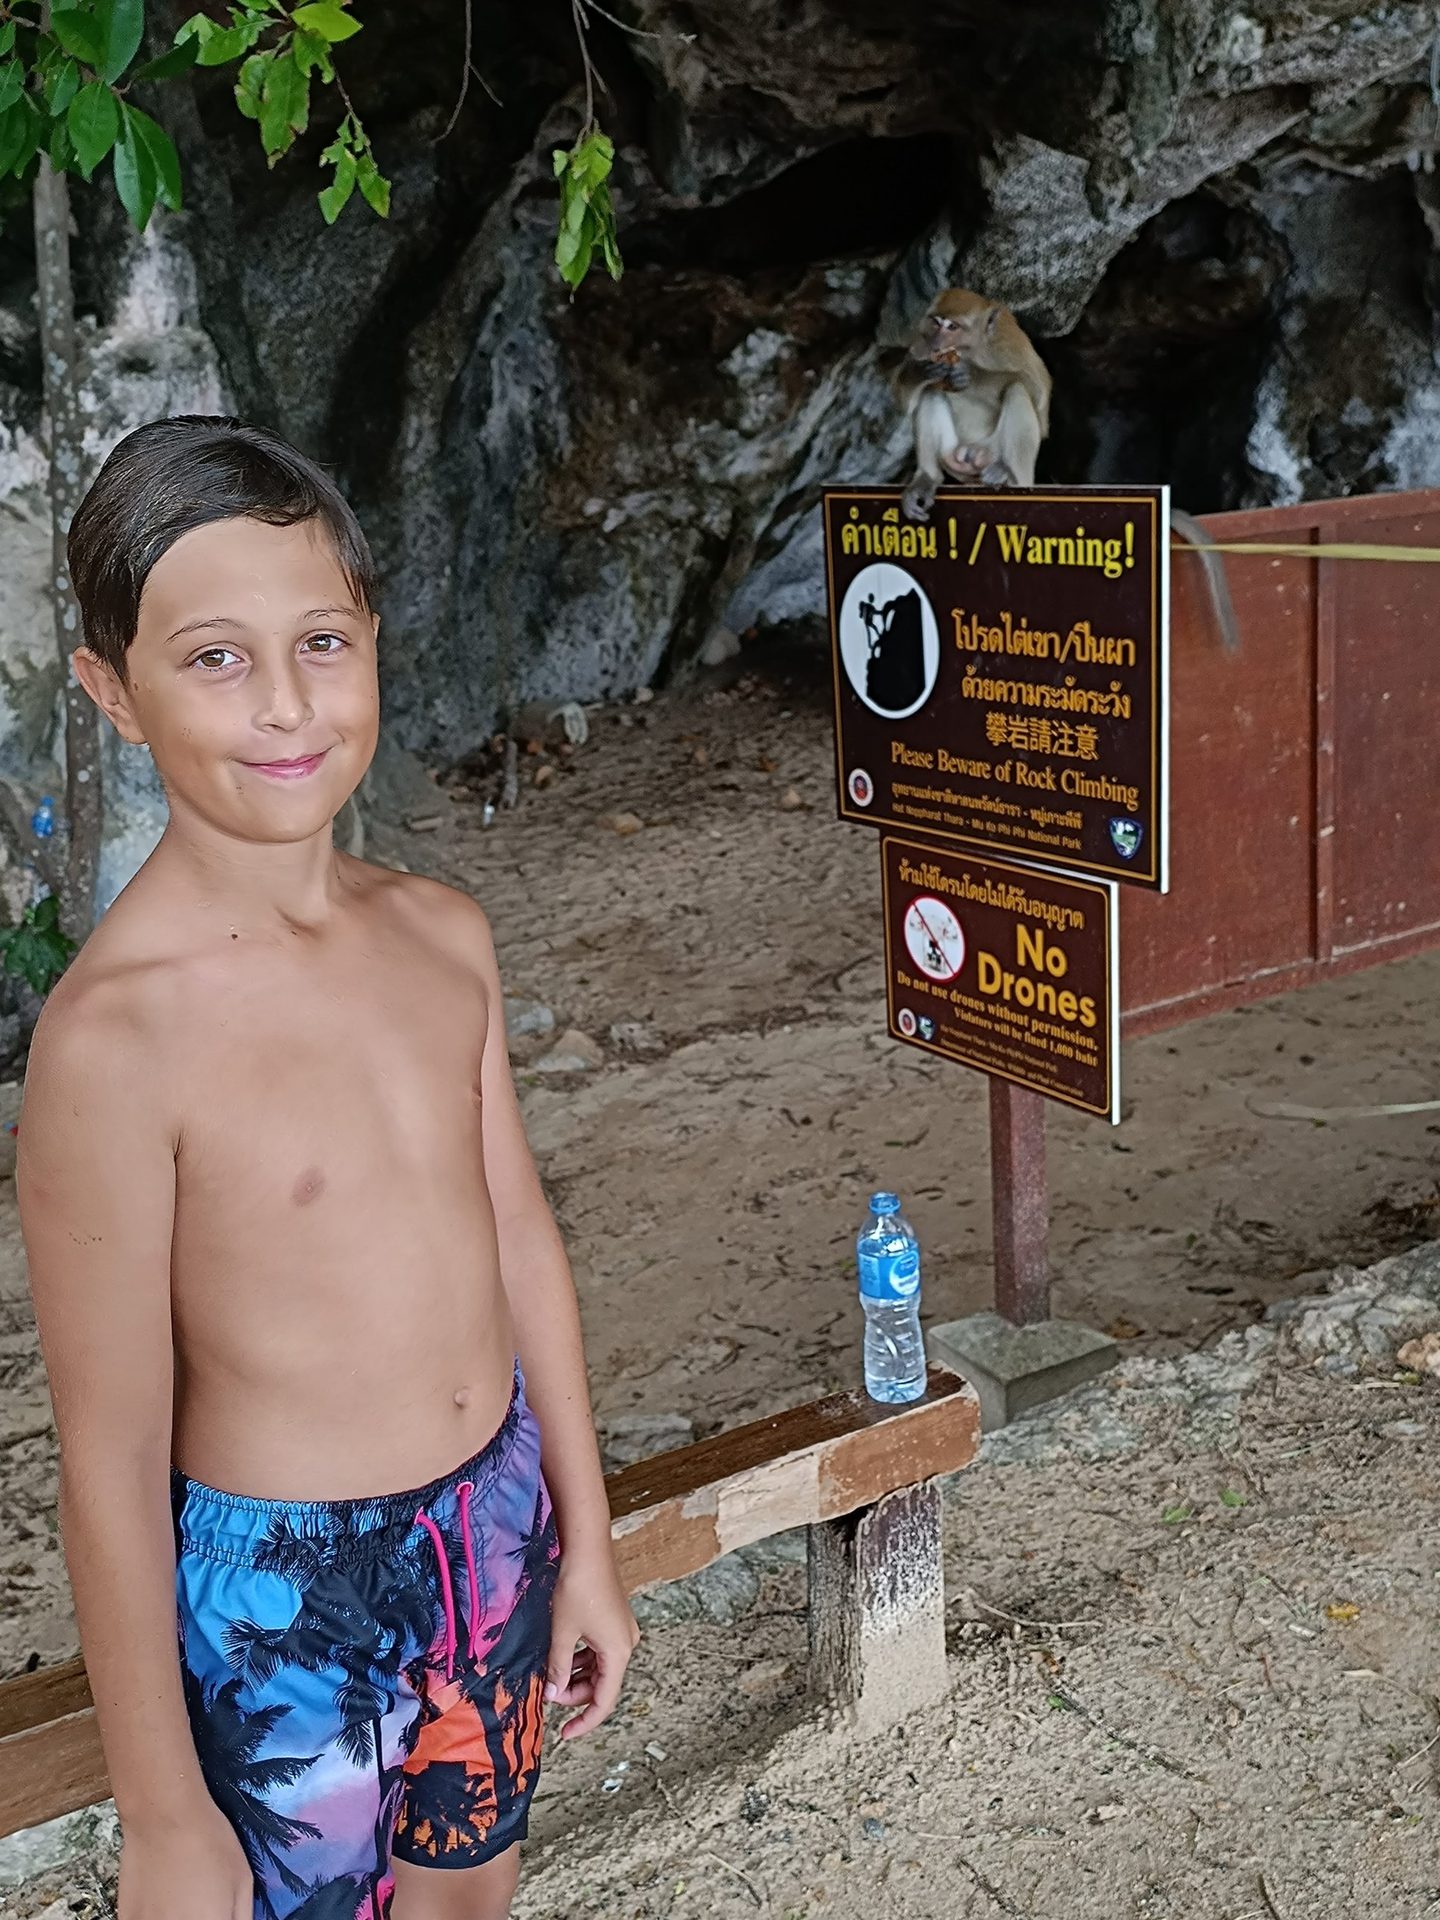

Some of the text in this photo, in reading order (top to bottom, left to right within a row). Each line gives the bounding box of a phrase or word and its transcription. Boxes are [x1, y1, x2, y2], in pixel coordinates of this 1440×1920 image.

[841, 505, 938, 559] คำเตือน
[995, 521, 1135, 579] Warning!
[961, 664, 1132, 719] ด้วยความระมัดระวัง
[985, 711, 1099, 760] 攀岩請注意
[891, 741, 1139, 812] Please Beware of Rock Climbing
[1016, 923, 1067, 978] No
[913, 979, 930, 993] not
[931, 985, 949, 1000] use
[949, 989, 986, 1013] drones
[987, 1003, 1029, 1028] without
[977, 950, 1097, 1028] Drones
[994, 1022, 1010, 1036] will
